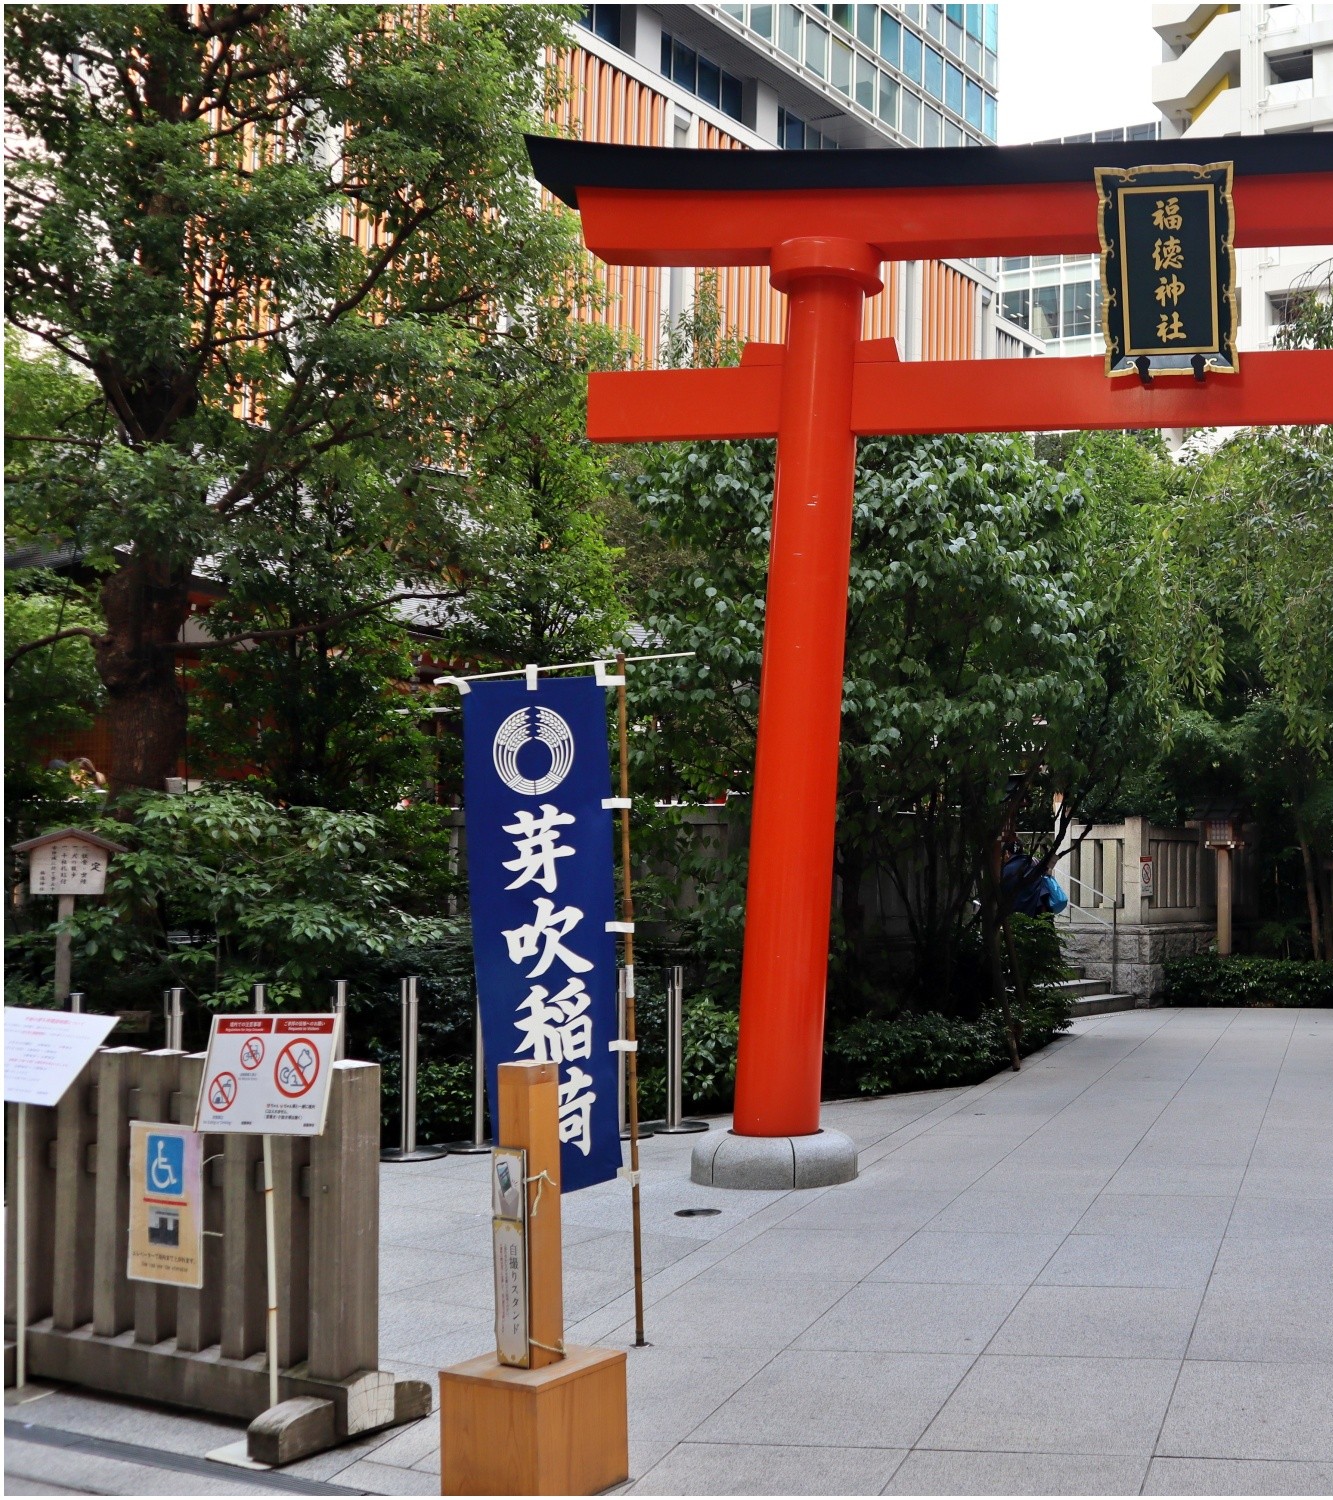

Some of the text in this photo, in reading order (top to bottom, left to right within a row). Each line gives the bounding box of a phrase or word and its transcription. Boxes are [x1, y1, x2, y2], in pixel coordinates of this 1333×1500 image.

[1152, 197, 1187, 343] 福徳神社
[509, 1243, 520, 1335] 自撮りスタンド
